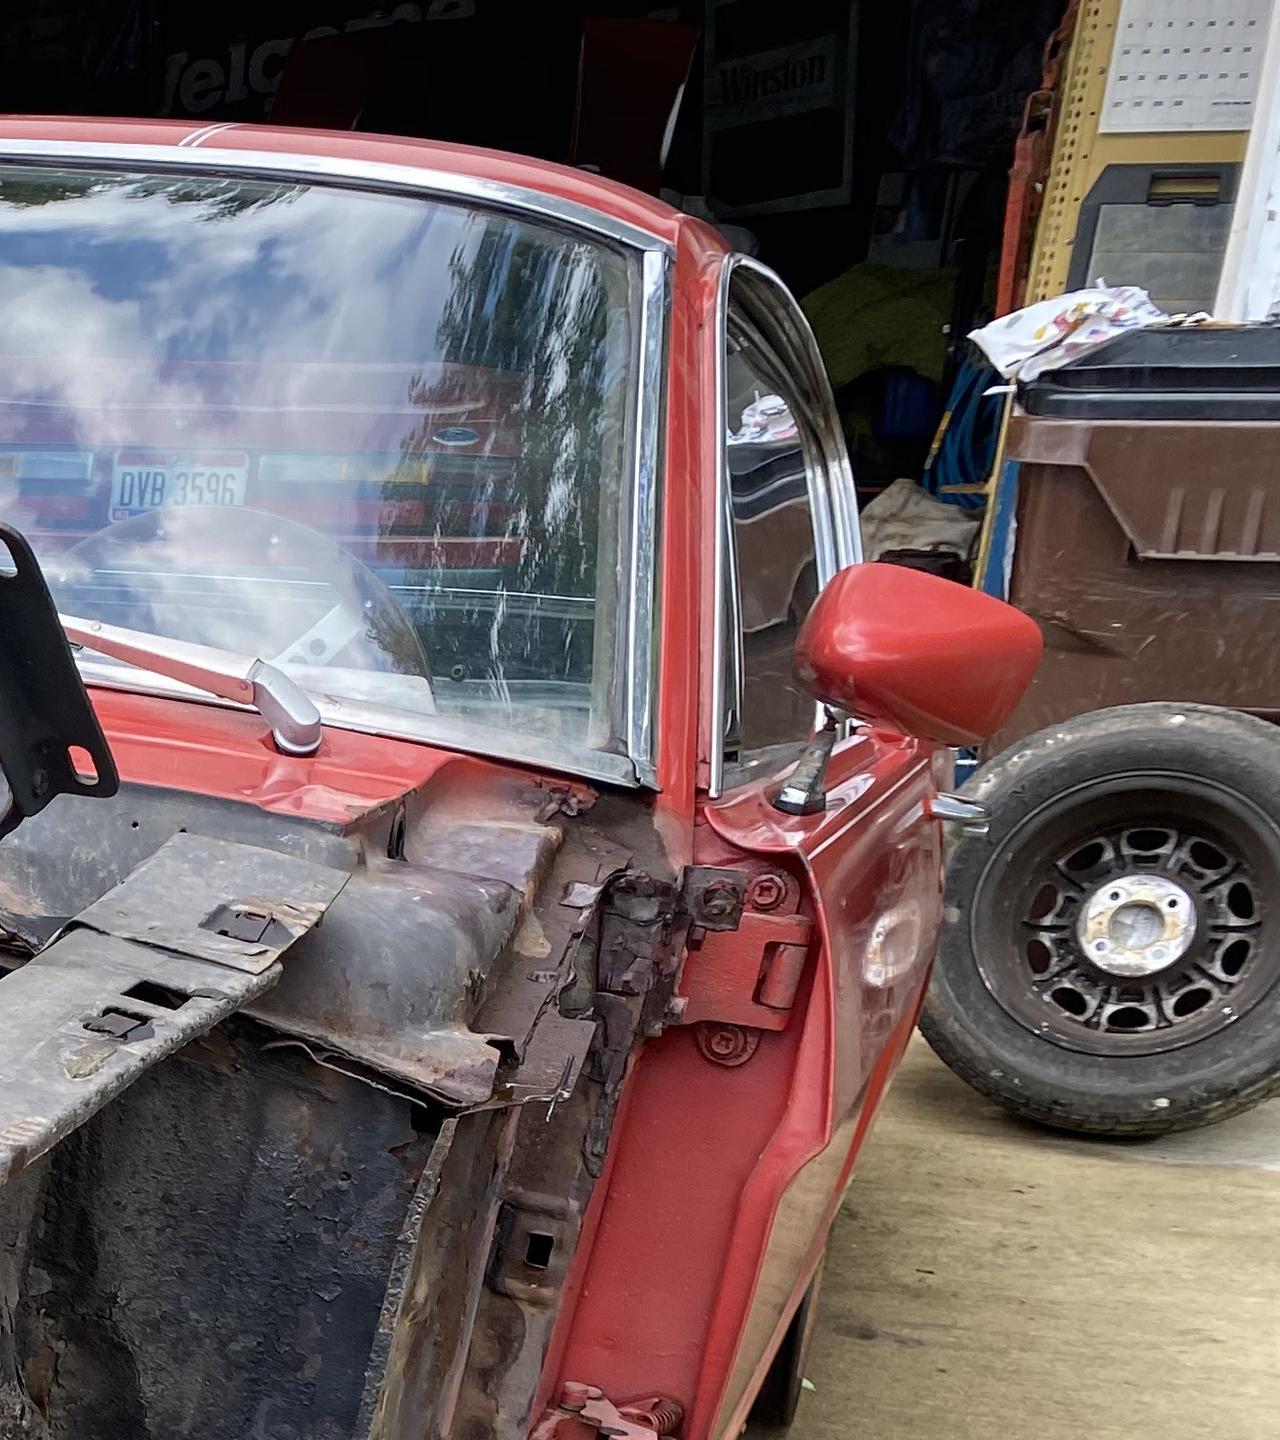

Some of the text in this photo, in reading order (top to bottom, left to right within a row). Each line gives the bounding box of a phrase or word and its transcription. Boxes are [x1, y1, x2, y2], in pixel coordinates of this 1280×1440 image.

[721, 53, 826, 104] Winston
[120, 471, 237, 507] DVB 3596
